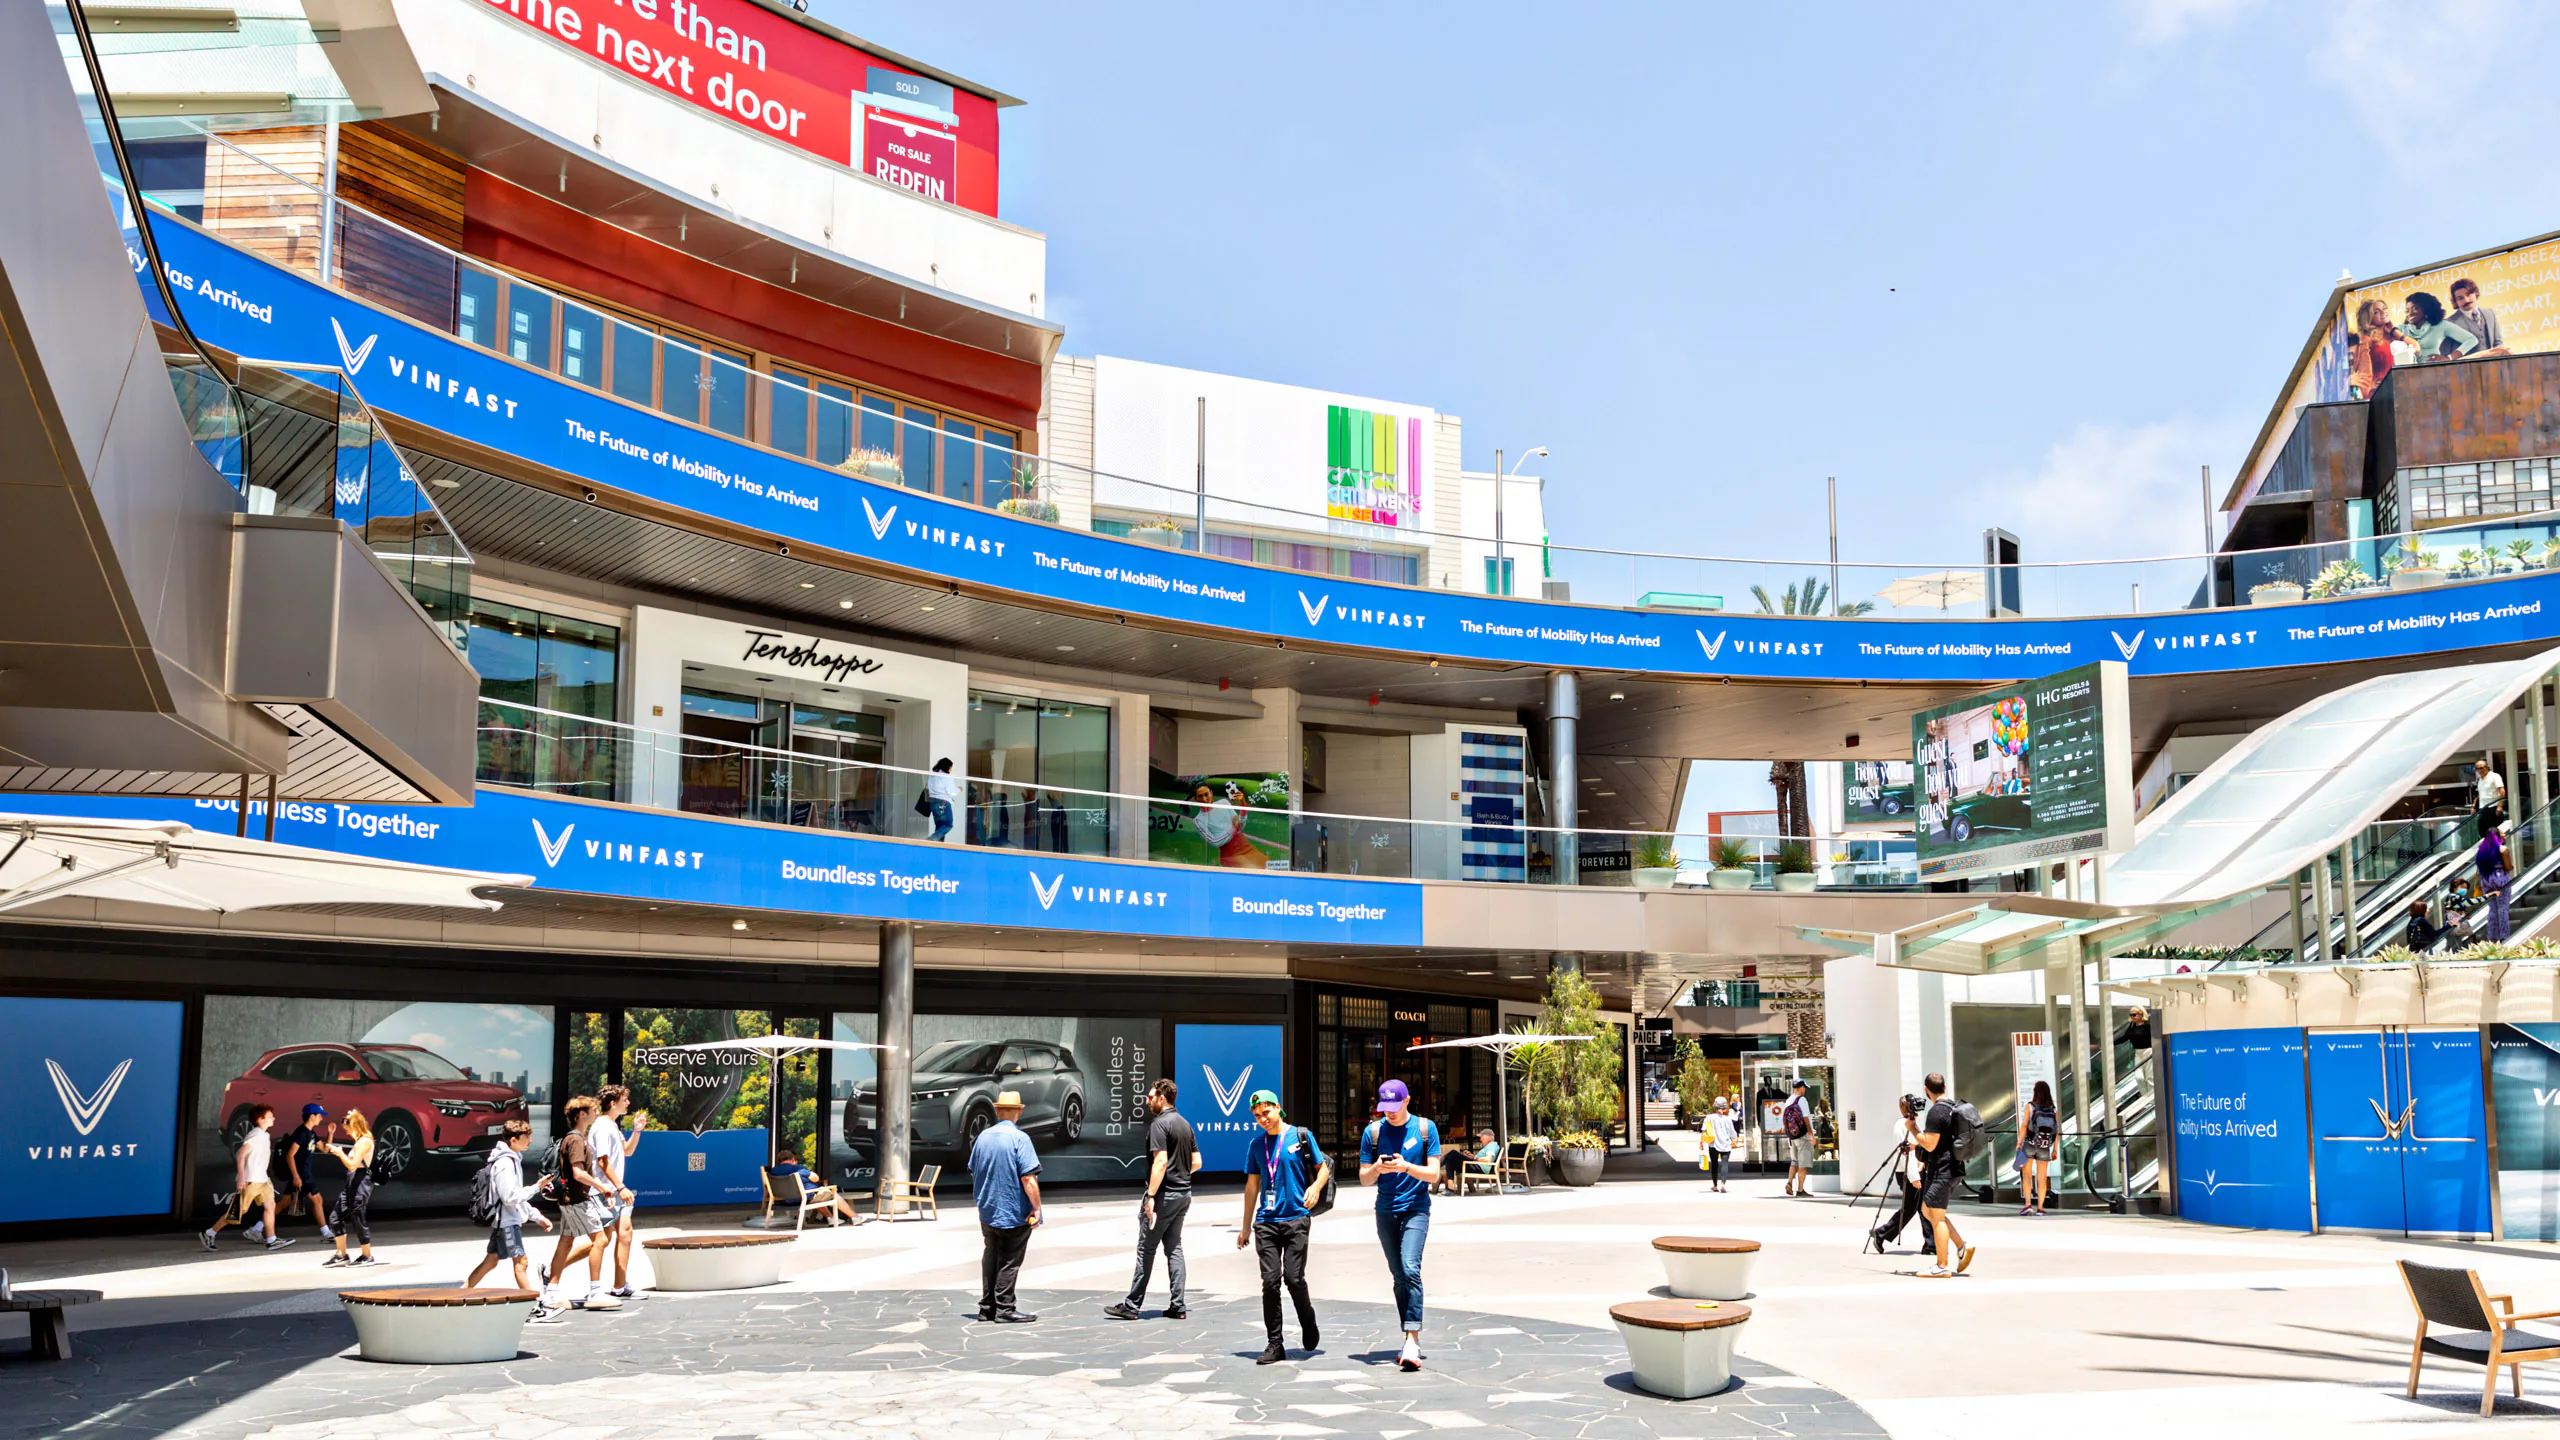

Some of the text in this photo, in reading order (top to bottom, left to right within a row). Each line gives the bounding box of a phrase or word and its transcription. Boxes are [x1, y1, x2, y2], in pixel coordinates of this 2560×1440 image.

[671, 0, 766, 72] than
[597, 22, 694, 95] next
[707, 72, 806, 138] door
[895, 81, 920, 96] SOLD
[888, 142, 932, 165] FOR SALE
[876, 156, 945, 201] REDFIN
[198, 279, 272, 324] Arrived
[2495, 292, 2556, 318] SMART,
[389, 355, 518, 419] VINFAST
[565, 419, 819, 513] The Future of Mobility Has Arrived
[1327, 469, 1397, 493] CAYTON
[1328, 486, 1422, 514] CHILDREN'S
[1327, 503, 1398, 527] MUSEUM
[905, 520, 1006, 558] VINFAST
[1033, 551, 1245, 604] The Future of Mobility Has Arrived
[1336, 606, 1427, 629] VINFAST
[2287, 600, 2541, 641] The Future of Mobility Has Arrived
[1460, 620, 1660, 648] The Future of Mobility Has Arrived
[2153, 630, 2257, 650] VINFAST
[743, 630, 883, 682] Tenshoppe
[1734, 640, 1824, 656] VINFAST
[1858, 642, 2071, 658] The Future of Mobility Has Arrived
[2036, 688, 2060, 707] IHG
[2061, 681, 2085, 693] HOTELS
[2062, 687, 2090, 700] RESORTS
[1917, 737, 1948, 765] Guest
[1854, 761, 1878, 781] how
[1924, 765, 1968, 798] how you
[1848, 785, 1880, 806] guest
[333, 803, 439, 840] Together
[1495, 813, 1510, 821] Body
[1919, 798, 1949, 832] guest
[584, 838, 704, 870] VINFAST
[1578, 856, 1628, 867] FOREVER 21
[782, 859, 960, 895] Boundless Together
[1072, 885, 1168, 907] VINFAST
[1232, 896, 1386, 922] Boundless Together
[1394, 1010, 1426, 1022] COACH
[1633, 1031, 1657, 1044] PAIGE
[634, 1047, 759, 1067] Reserve Yours
[679, 1071, 721, 1089] Now
[1105, 1036, 1124, 1136] Boundless
[1127, 1043, 1148, 1130] Together
[2180, 1092, 2247, 1111] The Future of
[1196, 1121, 1259, 1132] VINFAST
[2200, 1119, 2222, 1136] Has
[2225, 1119, 2278, 1138] Arrived
[29, 1143, 138, 1160] VINFAST
[2366, 1146, 2429, 1154] VINFAST
[844, 1167, 876, 1178] VF9
